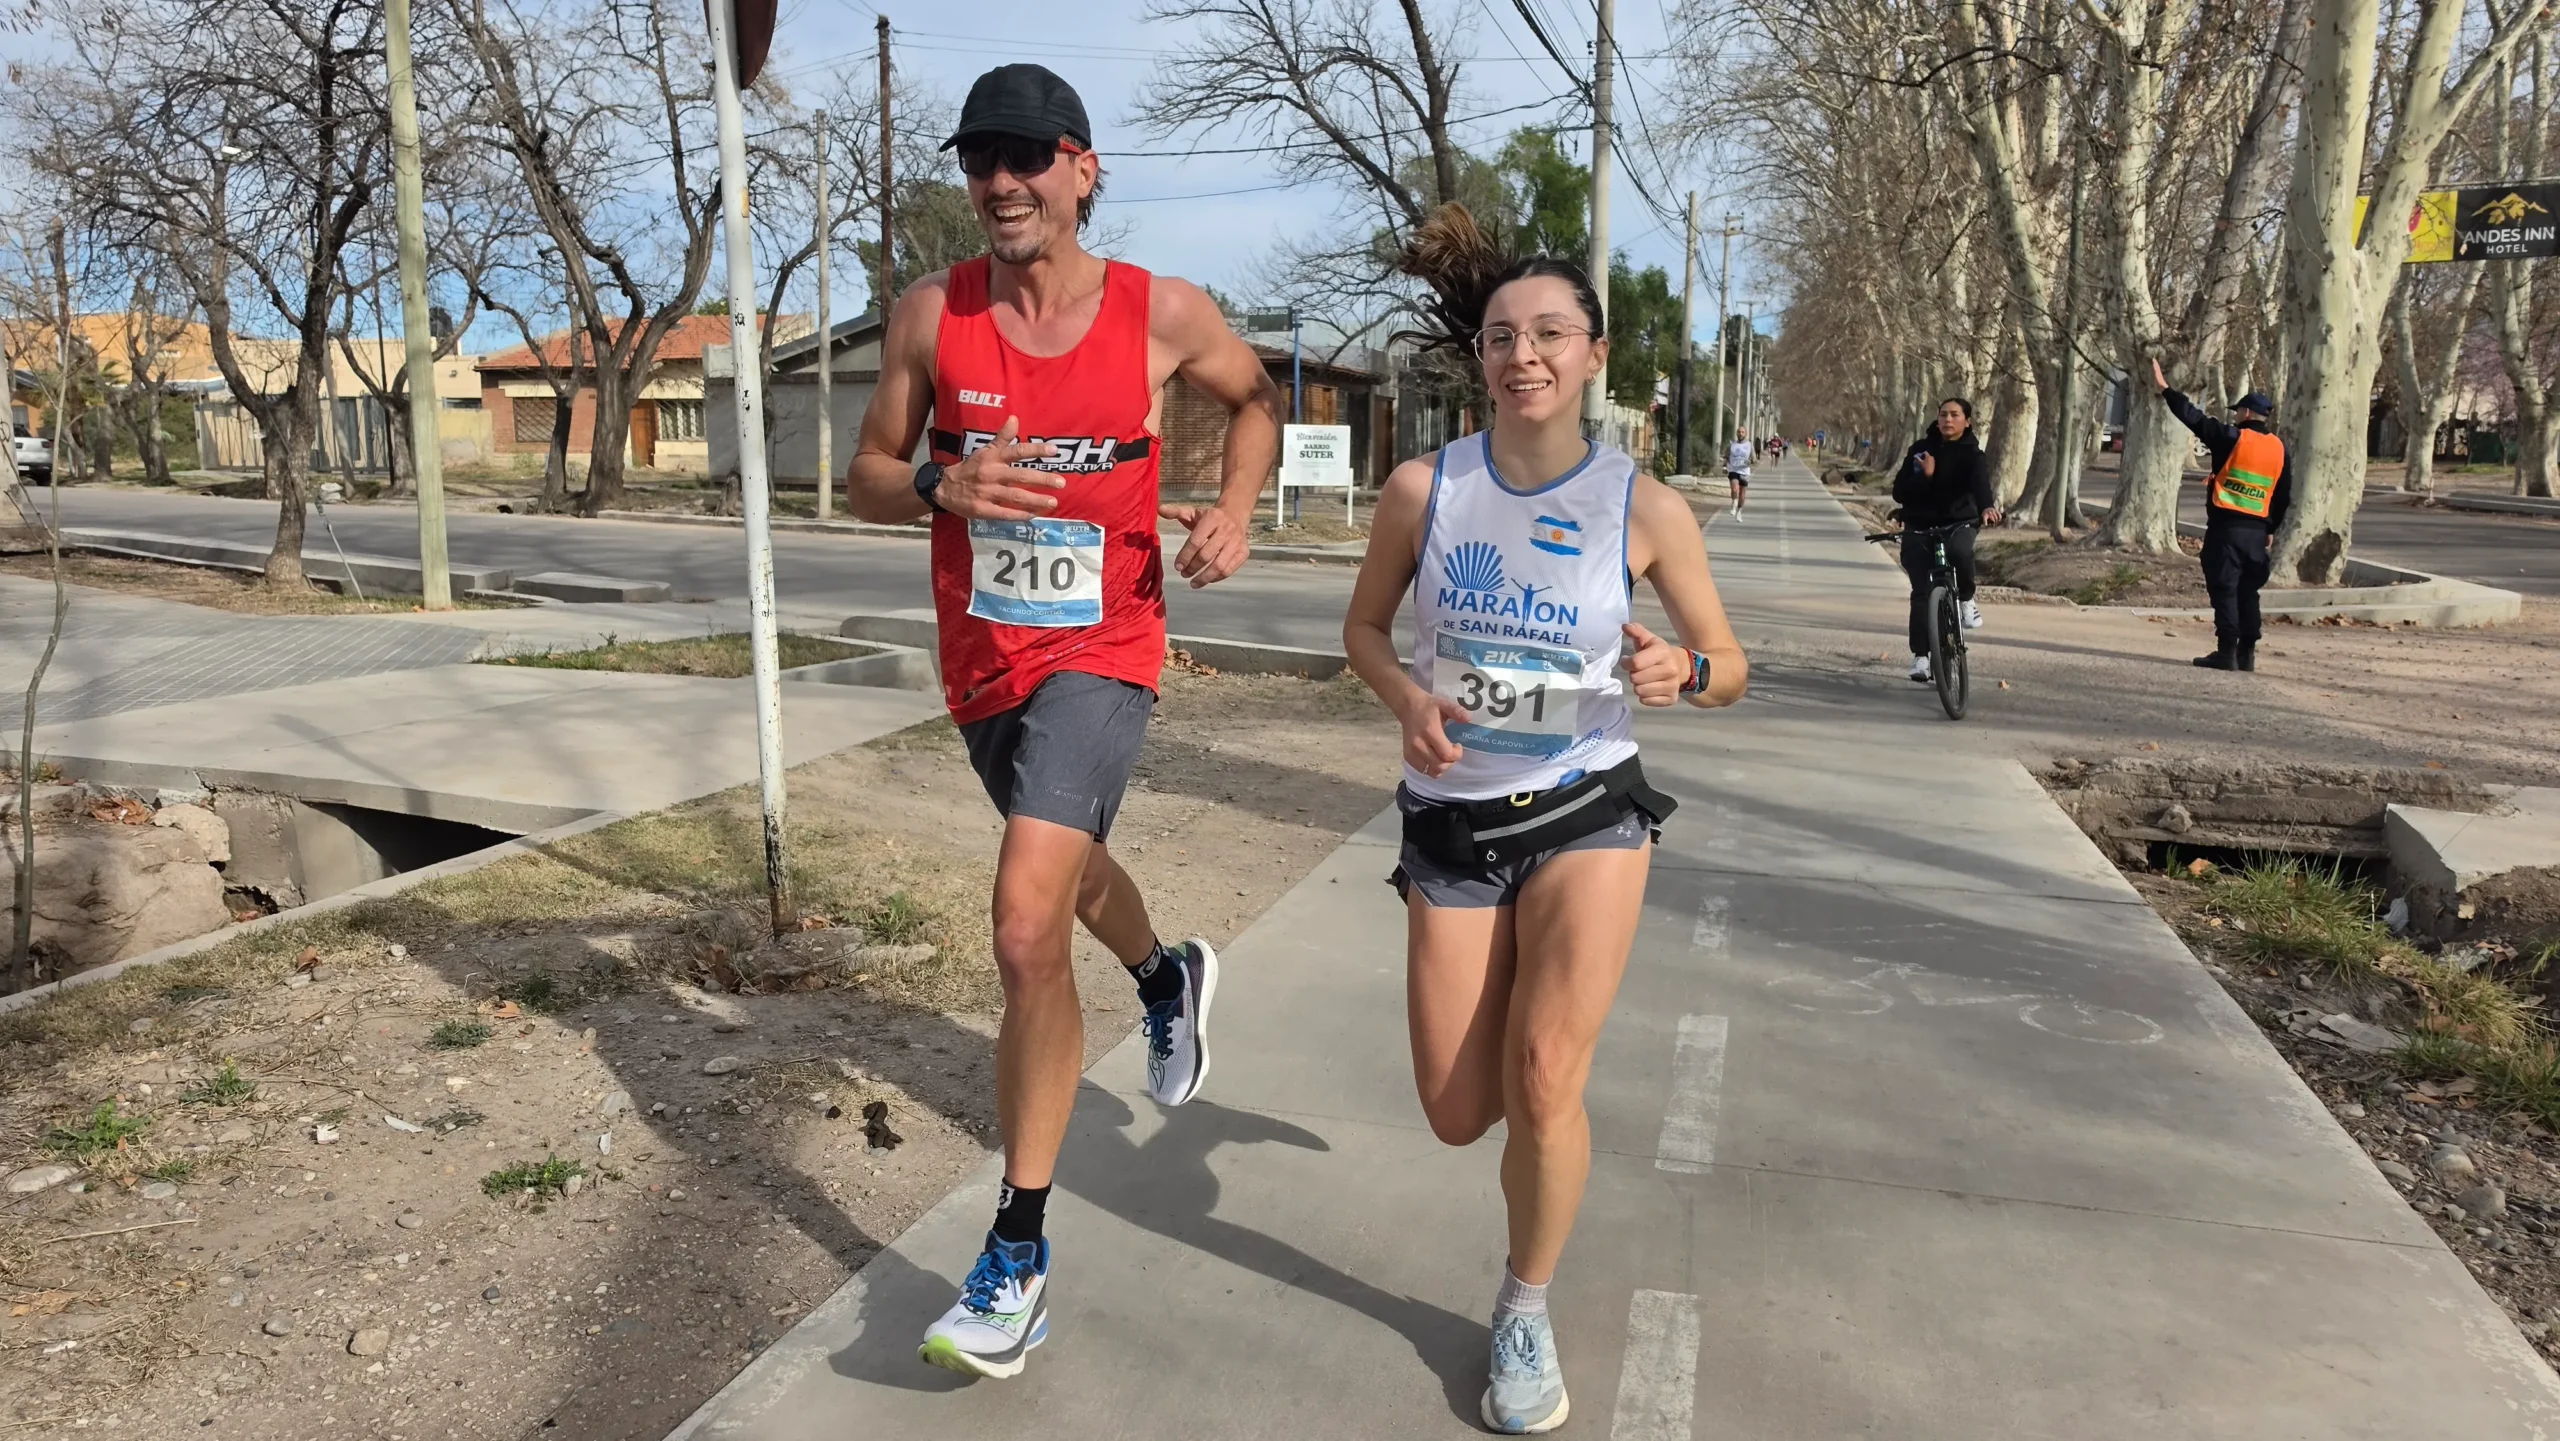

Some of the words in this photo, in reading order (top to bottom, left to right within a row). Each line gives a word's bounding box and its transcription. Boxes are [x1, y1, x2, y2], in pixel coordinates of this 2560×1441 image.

[2463, 228, 2521, 244] ANDES
[2525, 226, 2555, 241] INN
[2486, 244, 2528, 254] HOTEL
[1248, 308, 1258, 316] 20
[1259, 308, 1267, 316] de
[1299, 450, 1334, 458] SUTER
[1027, 462, 1113, 472] DEPORTIVA
[2224, 479, 2265, 498] POLICIA
[1015, 525, 1049, 541] 21K
[993, 550, 1076, 591] 210
[999, 606, 1032, 615] FACUNDO
[1444, 620, 1455, 629] DE
[1459, 619, 1498, 635] SAN
[1502, 626, 1571, 645] RAFAEL
[1483, 650, 1525, 665] 21K
[1457, 673, 1545, 722] 391
[1491, 739, 1535, 748] CAPOVILLA
